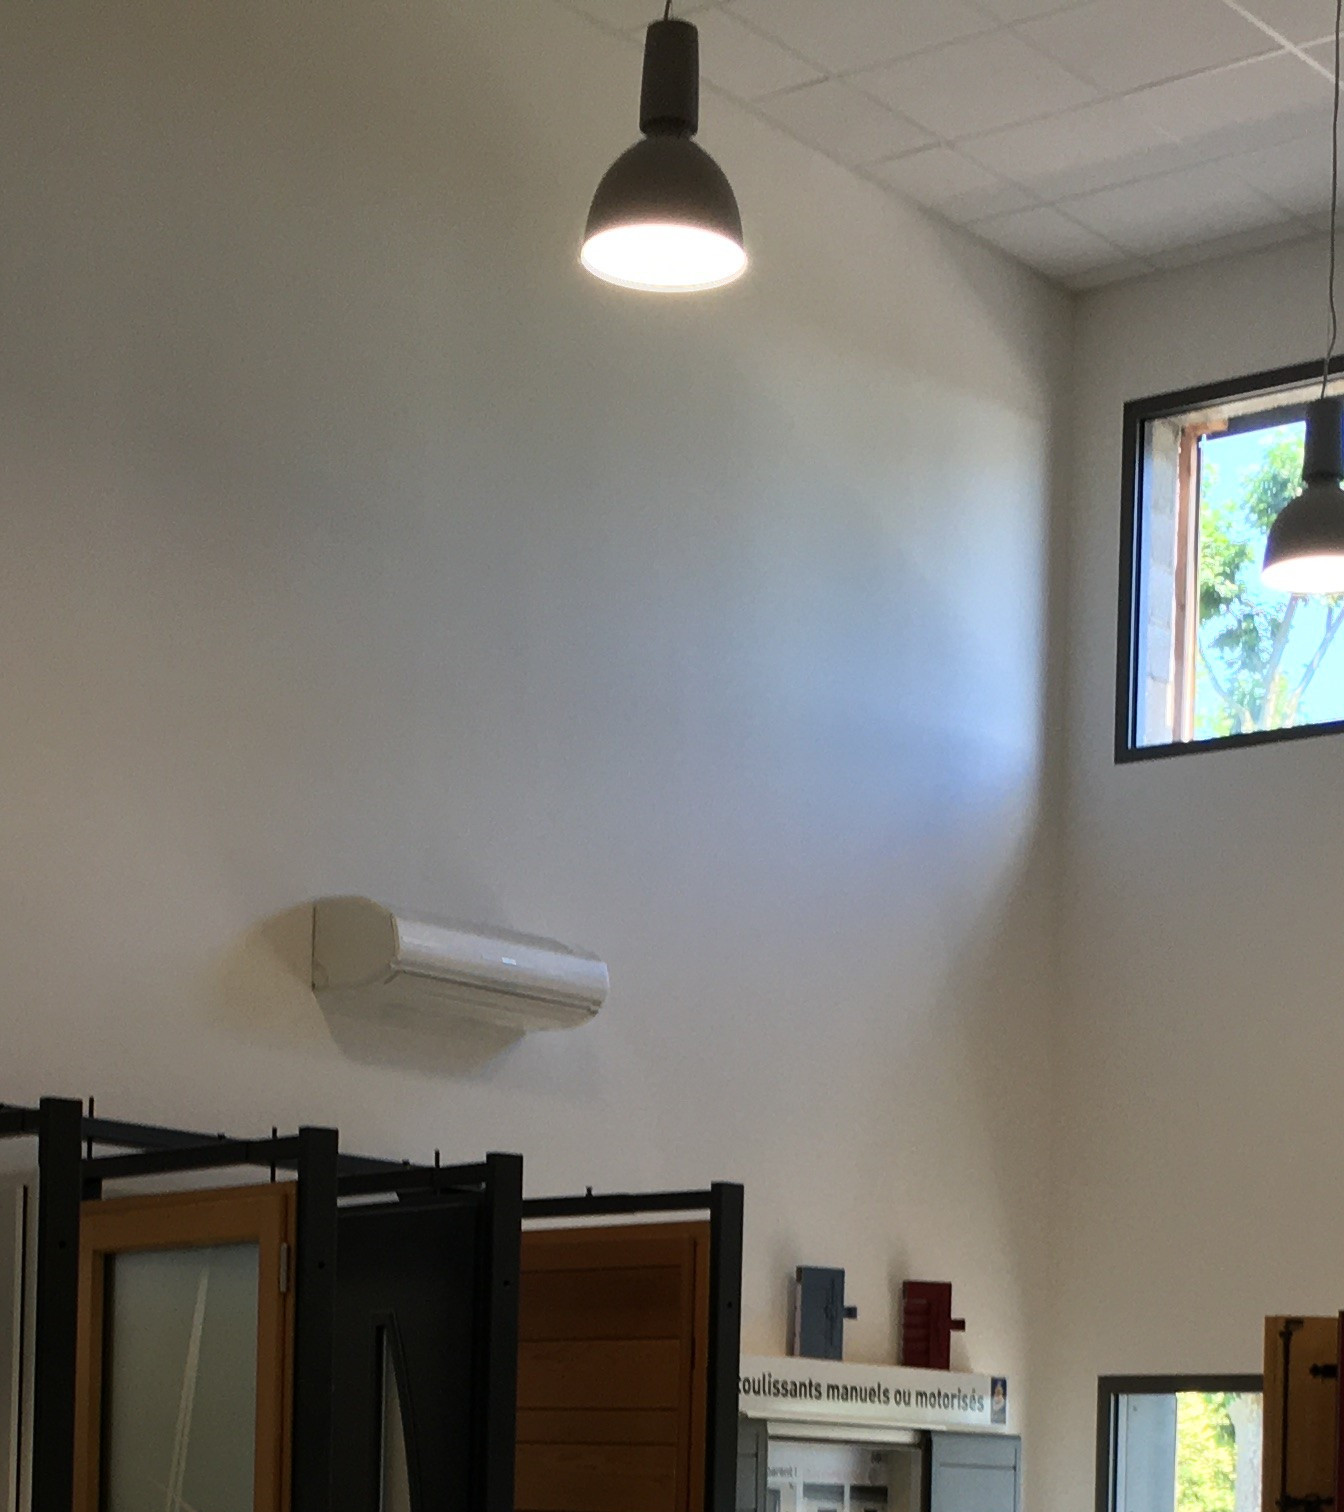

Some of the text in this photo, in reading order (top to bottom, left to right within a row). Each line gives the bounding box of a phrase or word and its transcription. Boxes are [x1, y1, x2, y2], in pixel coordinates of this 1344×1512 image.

[738, 1373, 984, 1413] oulissants manuels ou motorisés
